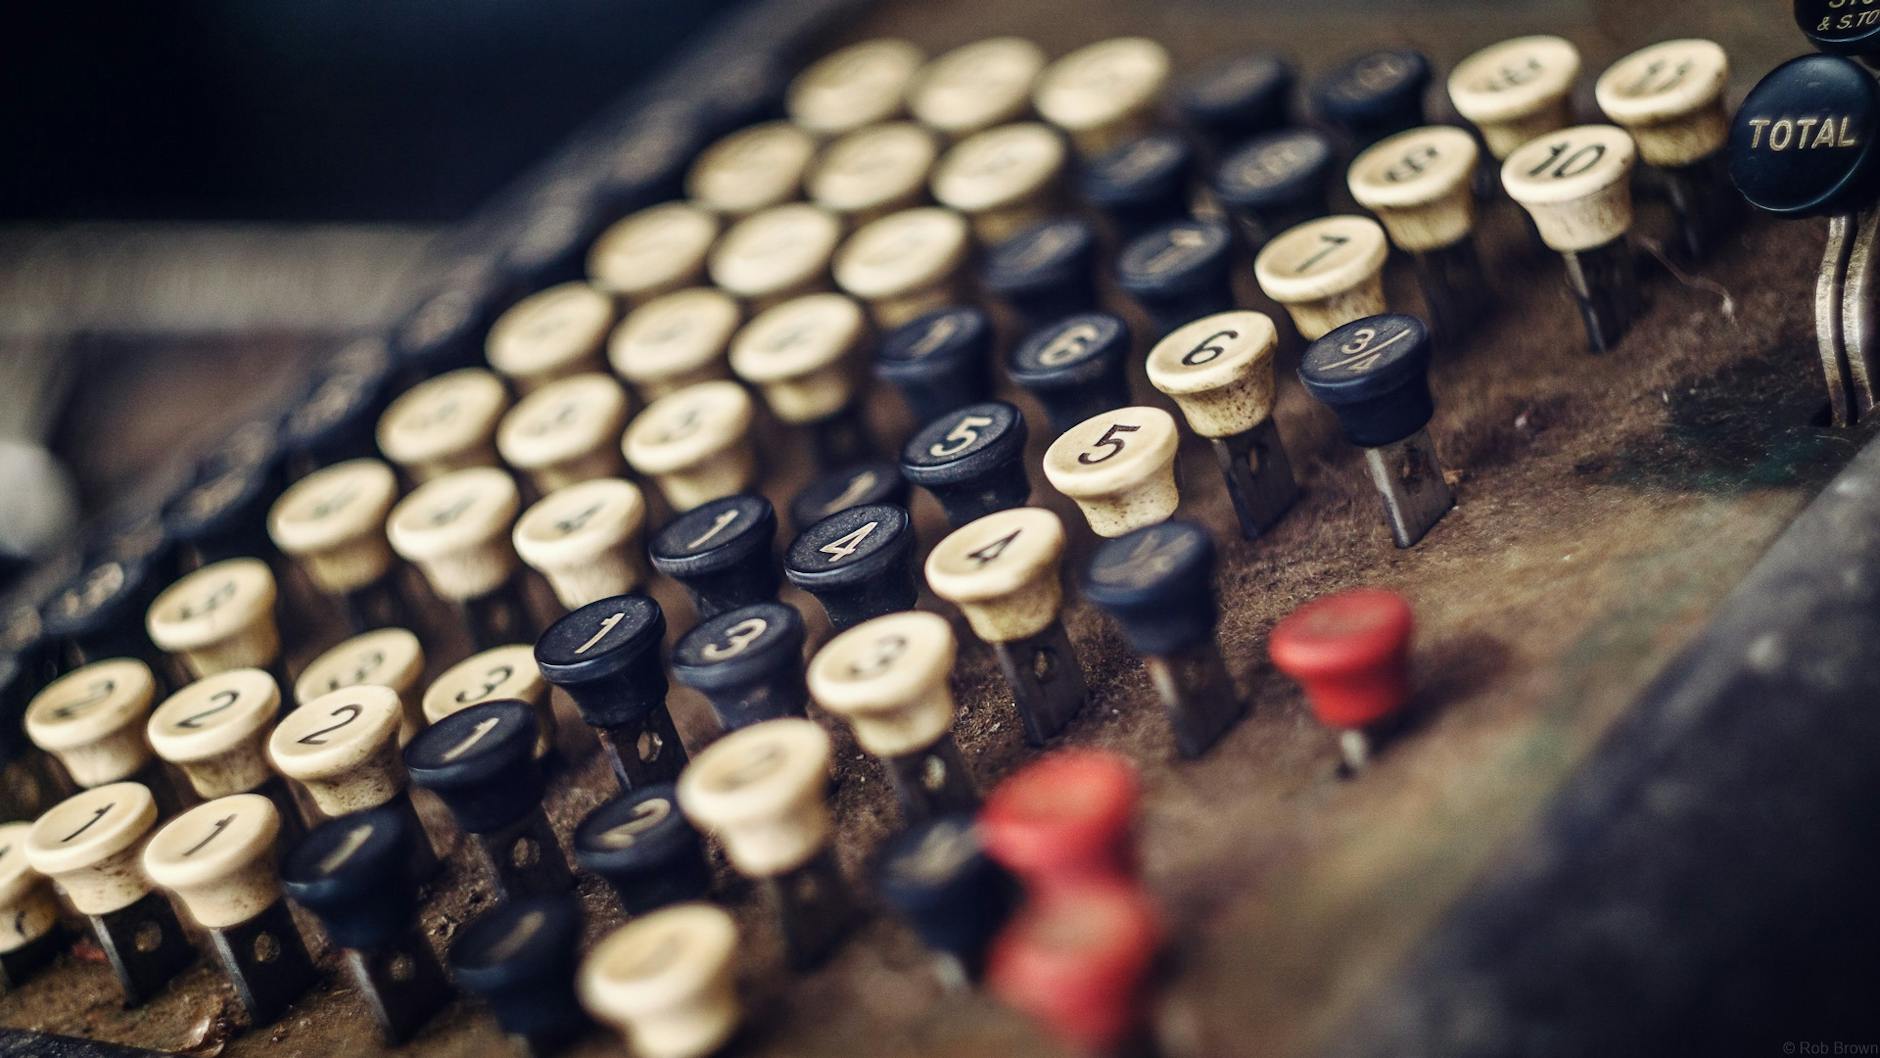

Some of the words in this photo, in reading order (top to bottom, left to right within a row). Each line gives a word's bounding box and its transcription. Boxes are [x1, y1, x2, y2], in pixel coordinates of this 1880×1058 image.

[1816, 15, 1830, 32] &
[1749, 117, 1857, 151] TOTAL
[1529, 142, 1607, 178] 10
[1039, 324, 1099, 366] 6
[1182, 330, 1239, 366] 6
[930, 415, 994, 457] 5
[1079, 424, 1141, 466] 5
[688, 509, 740, 549] 1
[820, 521, 878, 562] 4
[967, 528, 1024, 564] 4
[575, 612, 626, 655] 1
[703, 617, 768, 661] 3
[455, 665, 514, 702] 3
[176, 689, 240, 729] 2
[297, 703, 363, 745] 2
[443, 716, 500, 763] 1
[61, 803, 116, 843] 1
[185, 813, 239, 857] 1
[597, 797, 672, 847] 2
